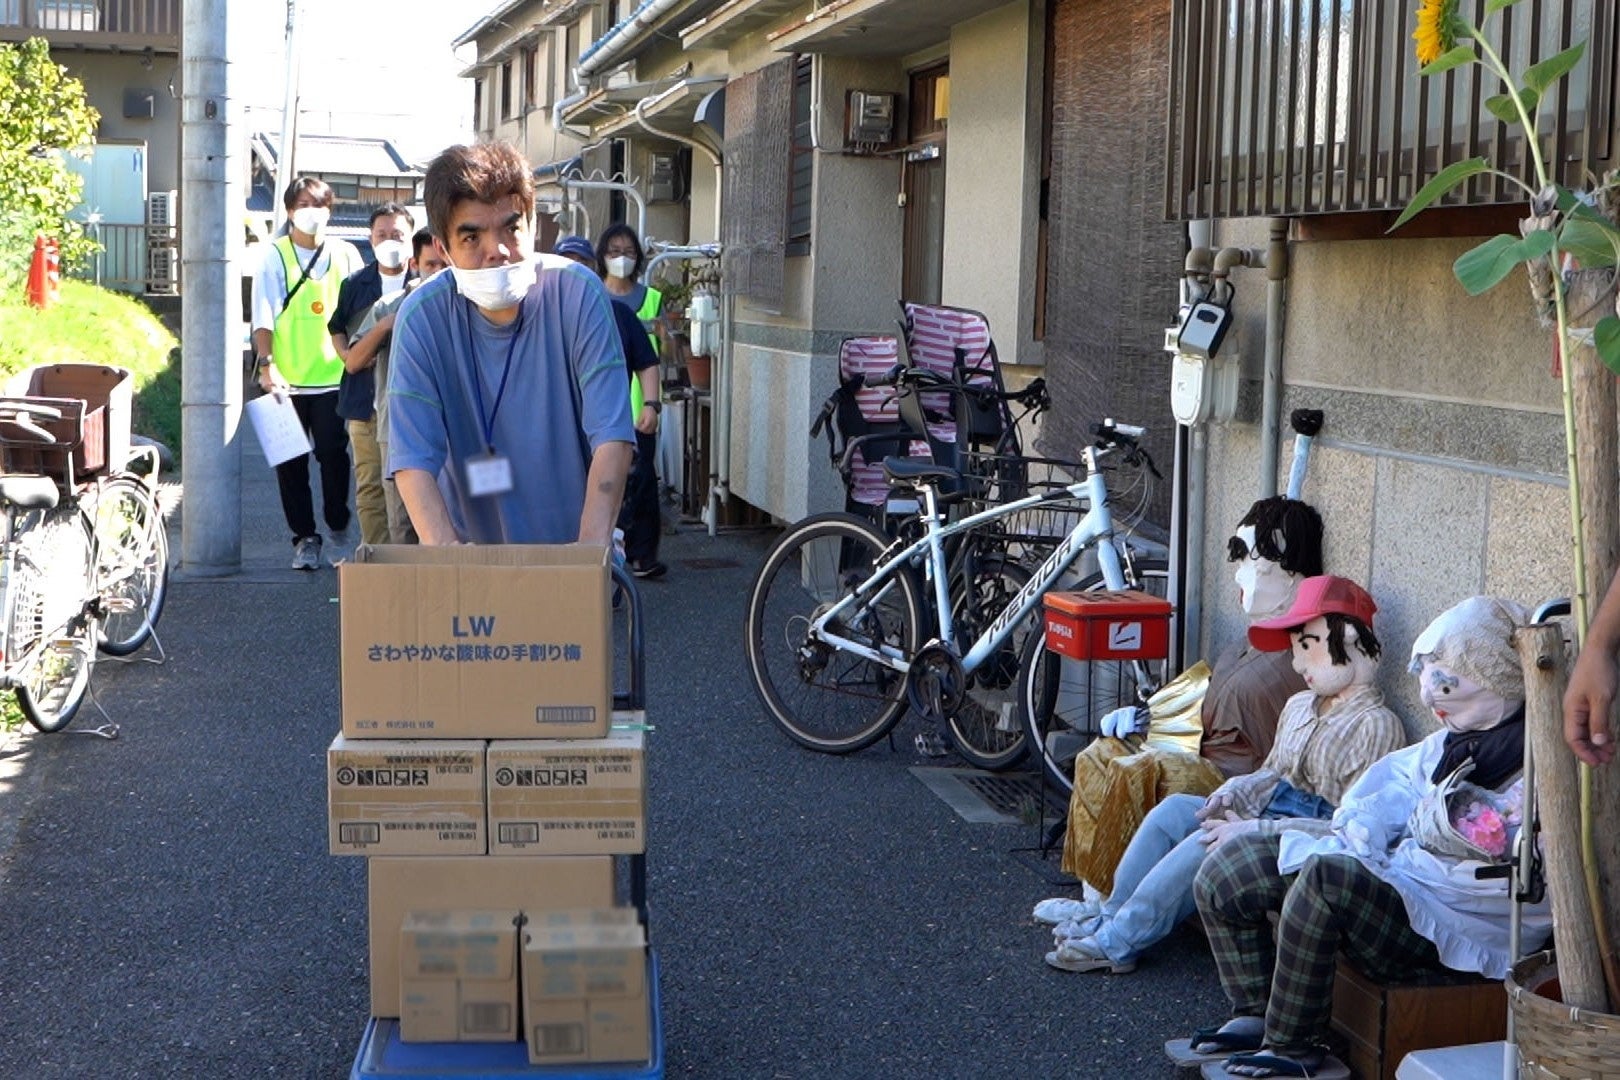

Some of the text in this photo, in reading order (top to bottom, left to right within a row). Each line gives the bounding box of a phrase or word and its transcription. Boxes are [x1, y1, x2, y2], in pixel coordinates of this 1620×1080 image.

[988, 535, 1073, 644] MERIDA
[452, 615, 496, 638] LW
[368, 644, 582, 663] さわやかな酸味の手割り梅
